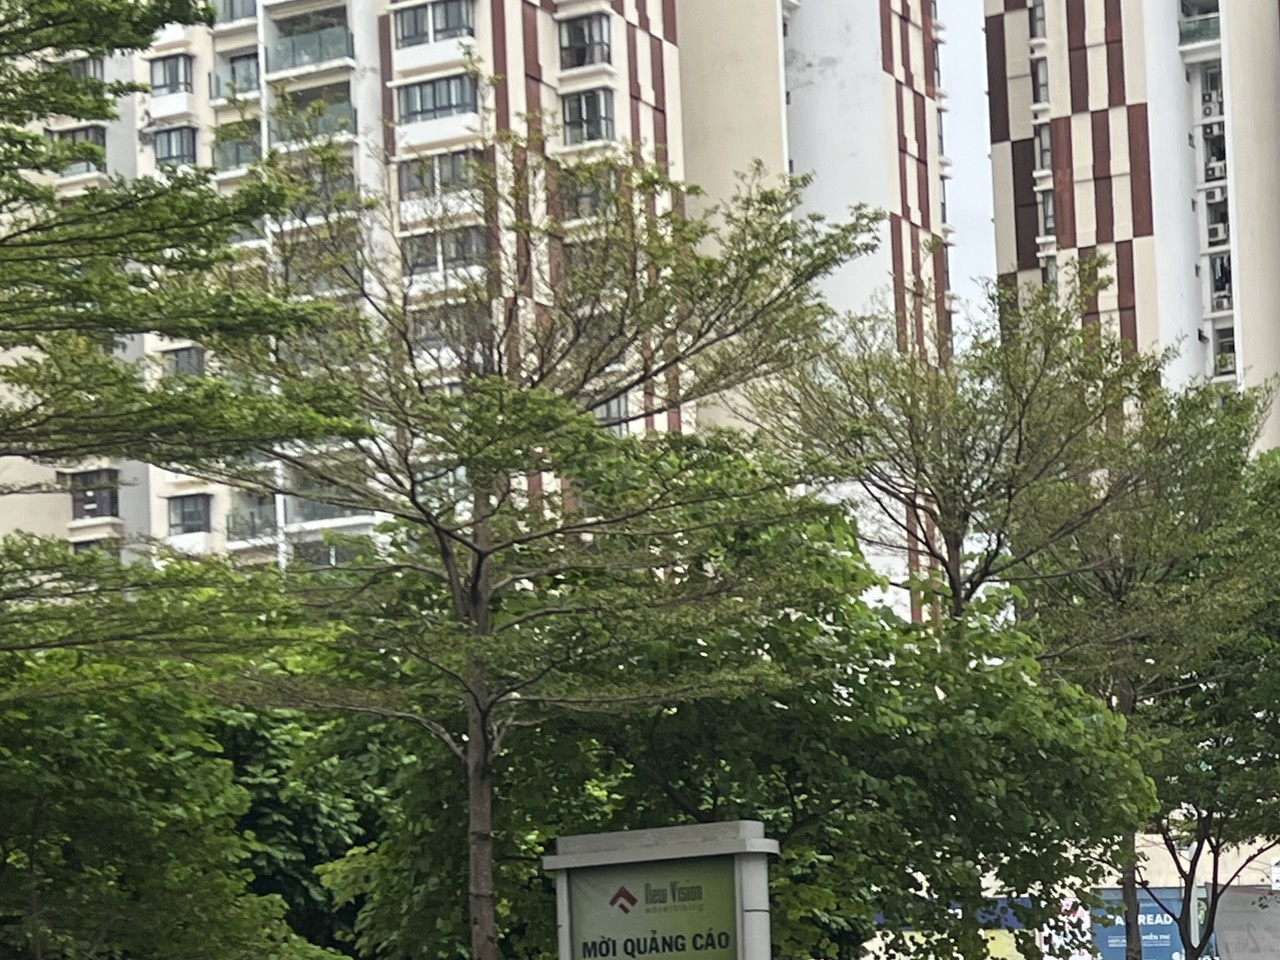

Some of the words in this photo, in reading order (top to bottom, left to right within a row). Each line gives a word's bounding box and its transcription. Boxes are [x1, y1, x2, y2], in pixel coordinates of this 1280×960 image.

[670, 879, 703, 902] Vision
[582, 935, 617, 959] MỜI
[623, 929, 686, 958] QUẢNG
[692, 926, 730, 951] CÁO
